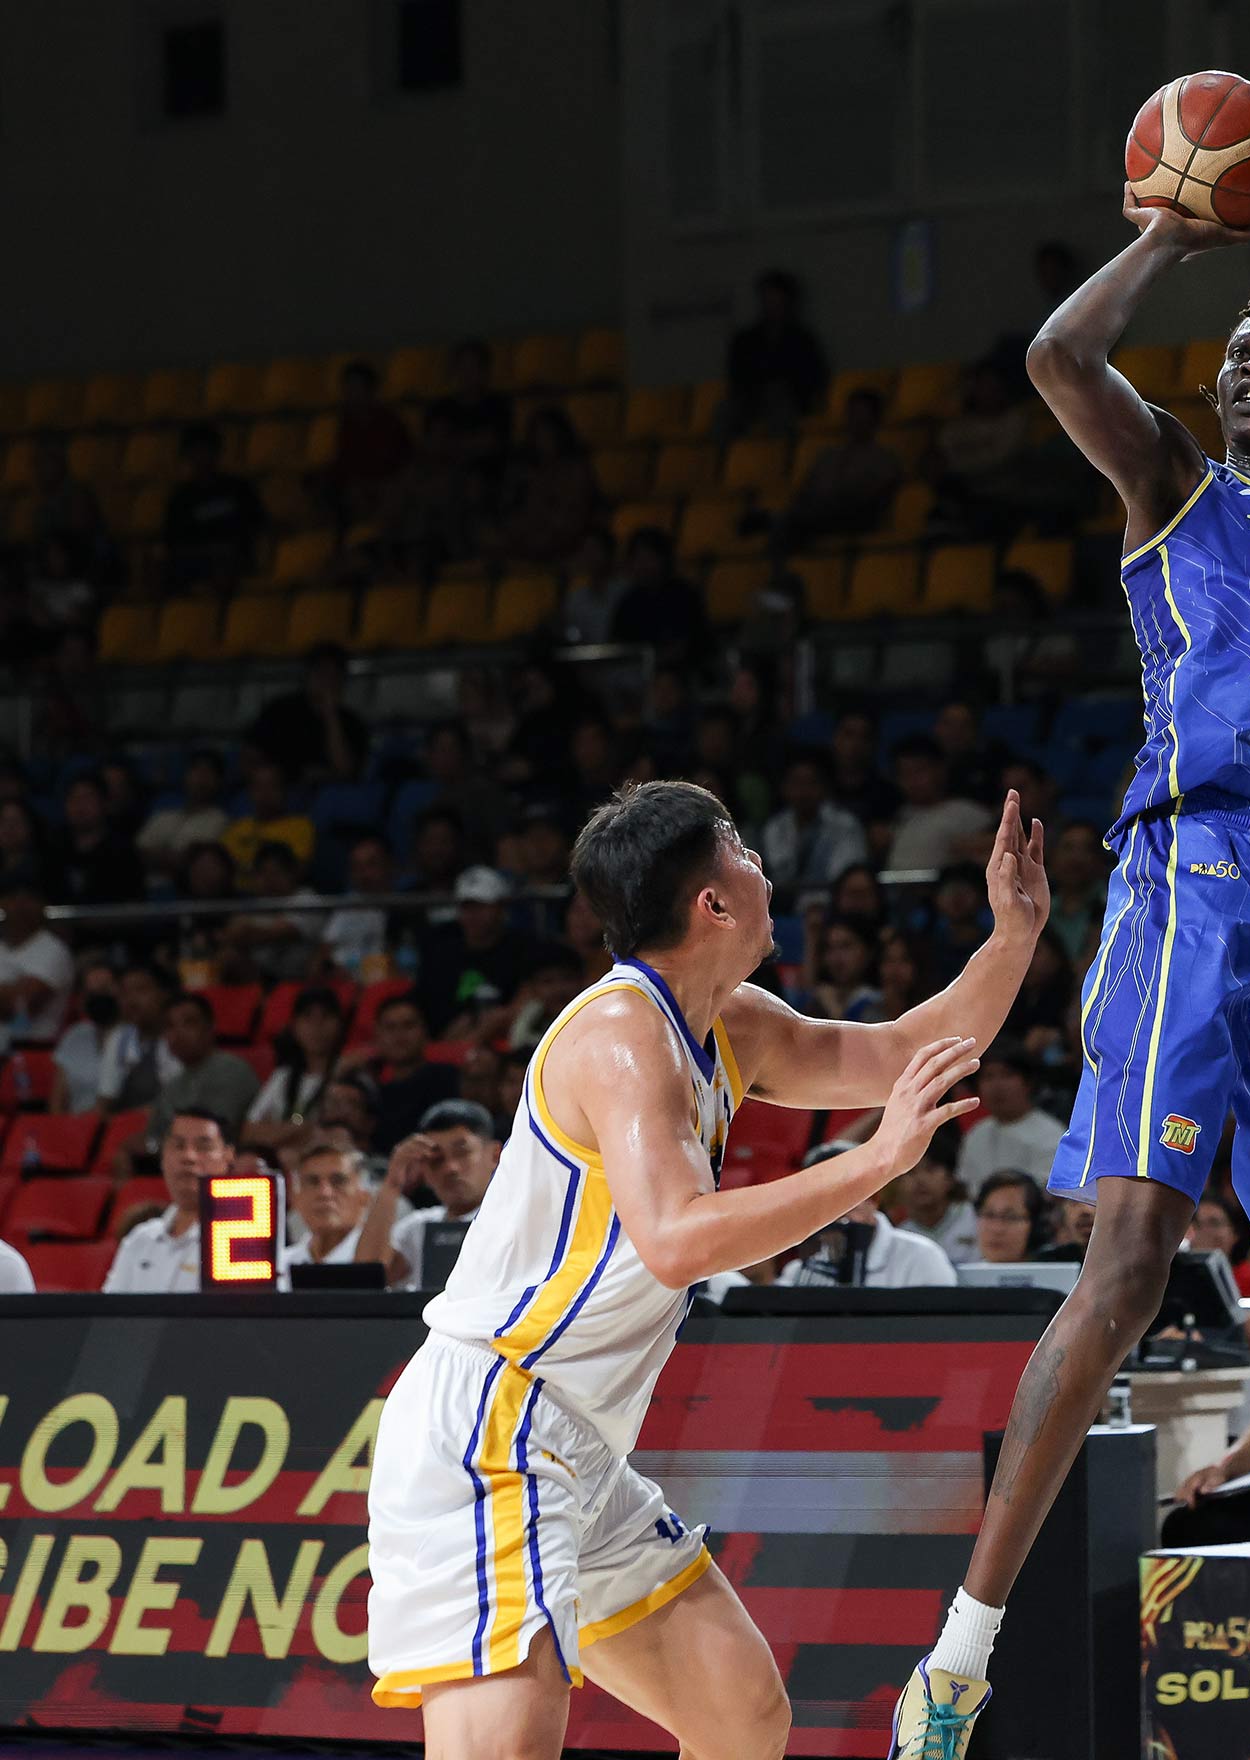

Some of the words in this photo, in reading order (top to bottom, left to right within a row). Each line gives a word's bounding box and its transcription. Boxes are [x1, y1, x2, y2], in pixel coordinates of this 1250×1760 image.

[1162, 1121, 1200, 1146] TNT
[211, 1178, 271, 1280] 2
[0, 1392, 290, 1515] OAD
